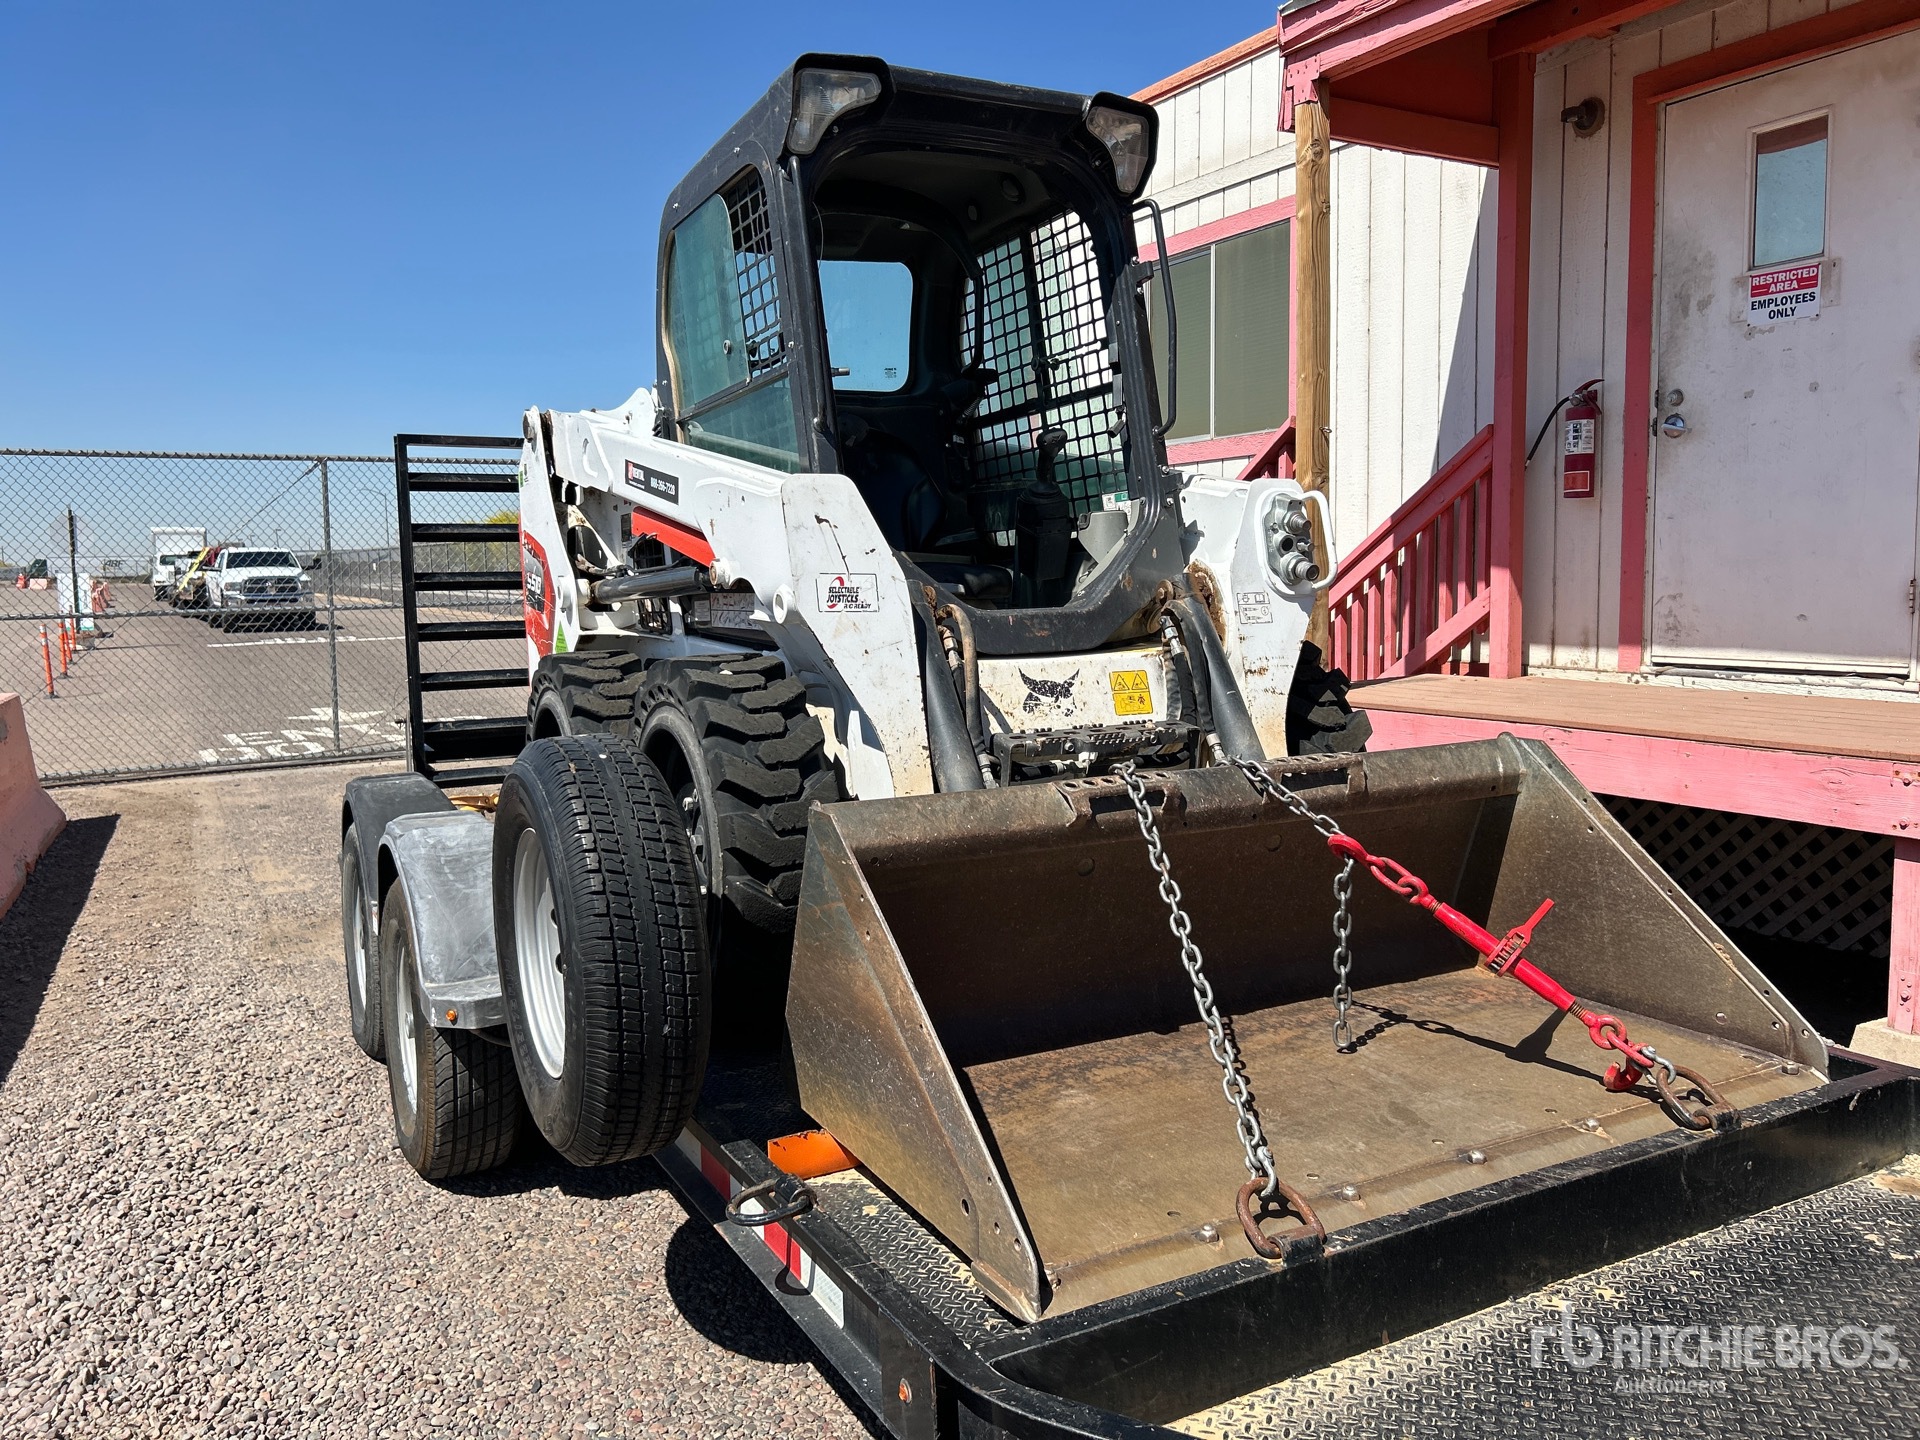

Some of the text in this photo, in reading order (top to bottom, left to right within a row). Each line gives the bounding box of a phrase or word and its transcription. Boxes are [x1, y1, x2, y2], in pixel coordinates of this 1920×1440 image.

[1752, 267, 1818, 286] RESTRICTED
[1768, 280, 1799, 293] AREA
[1751, 291, 1816, 311] EMPLOYEES
[1768, 306, 1797, 320] ONLY
[828, 586, 860, 594] SELECTABLE
[826, 594, 859, 603] JOYSTICKS
